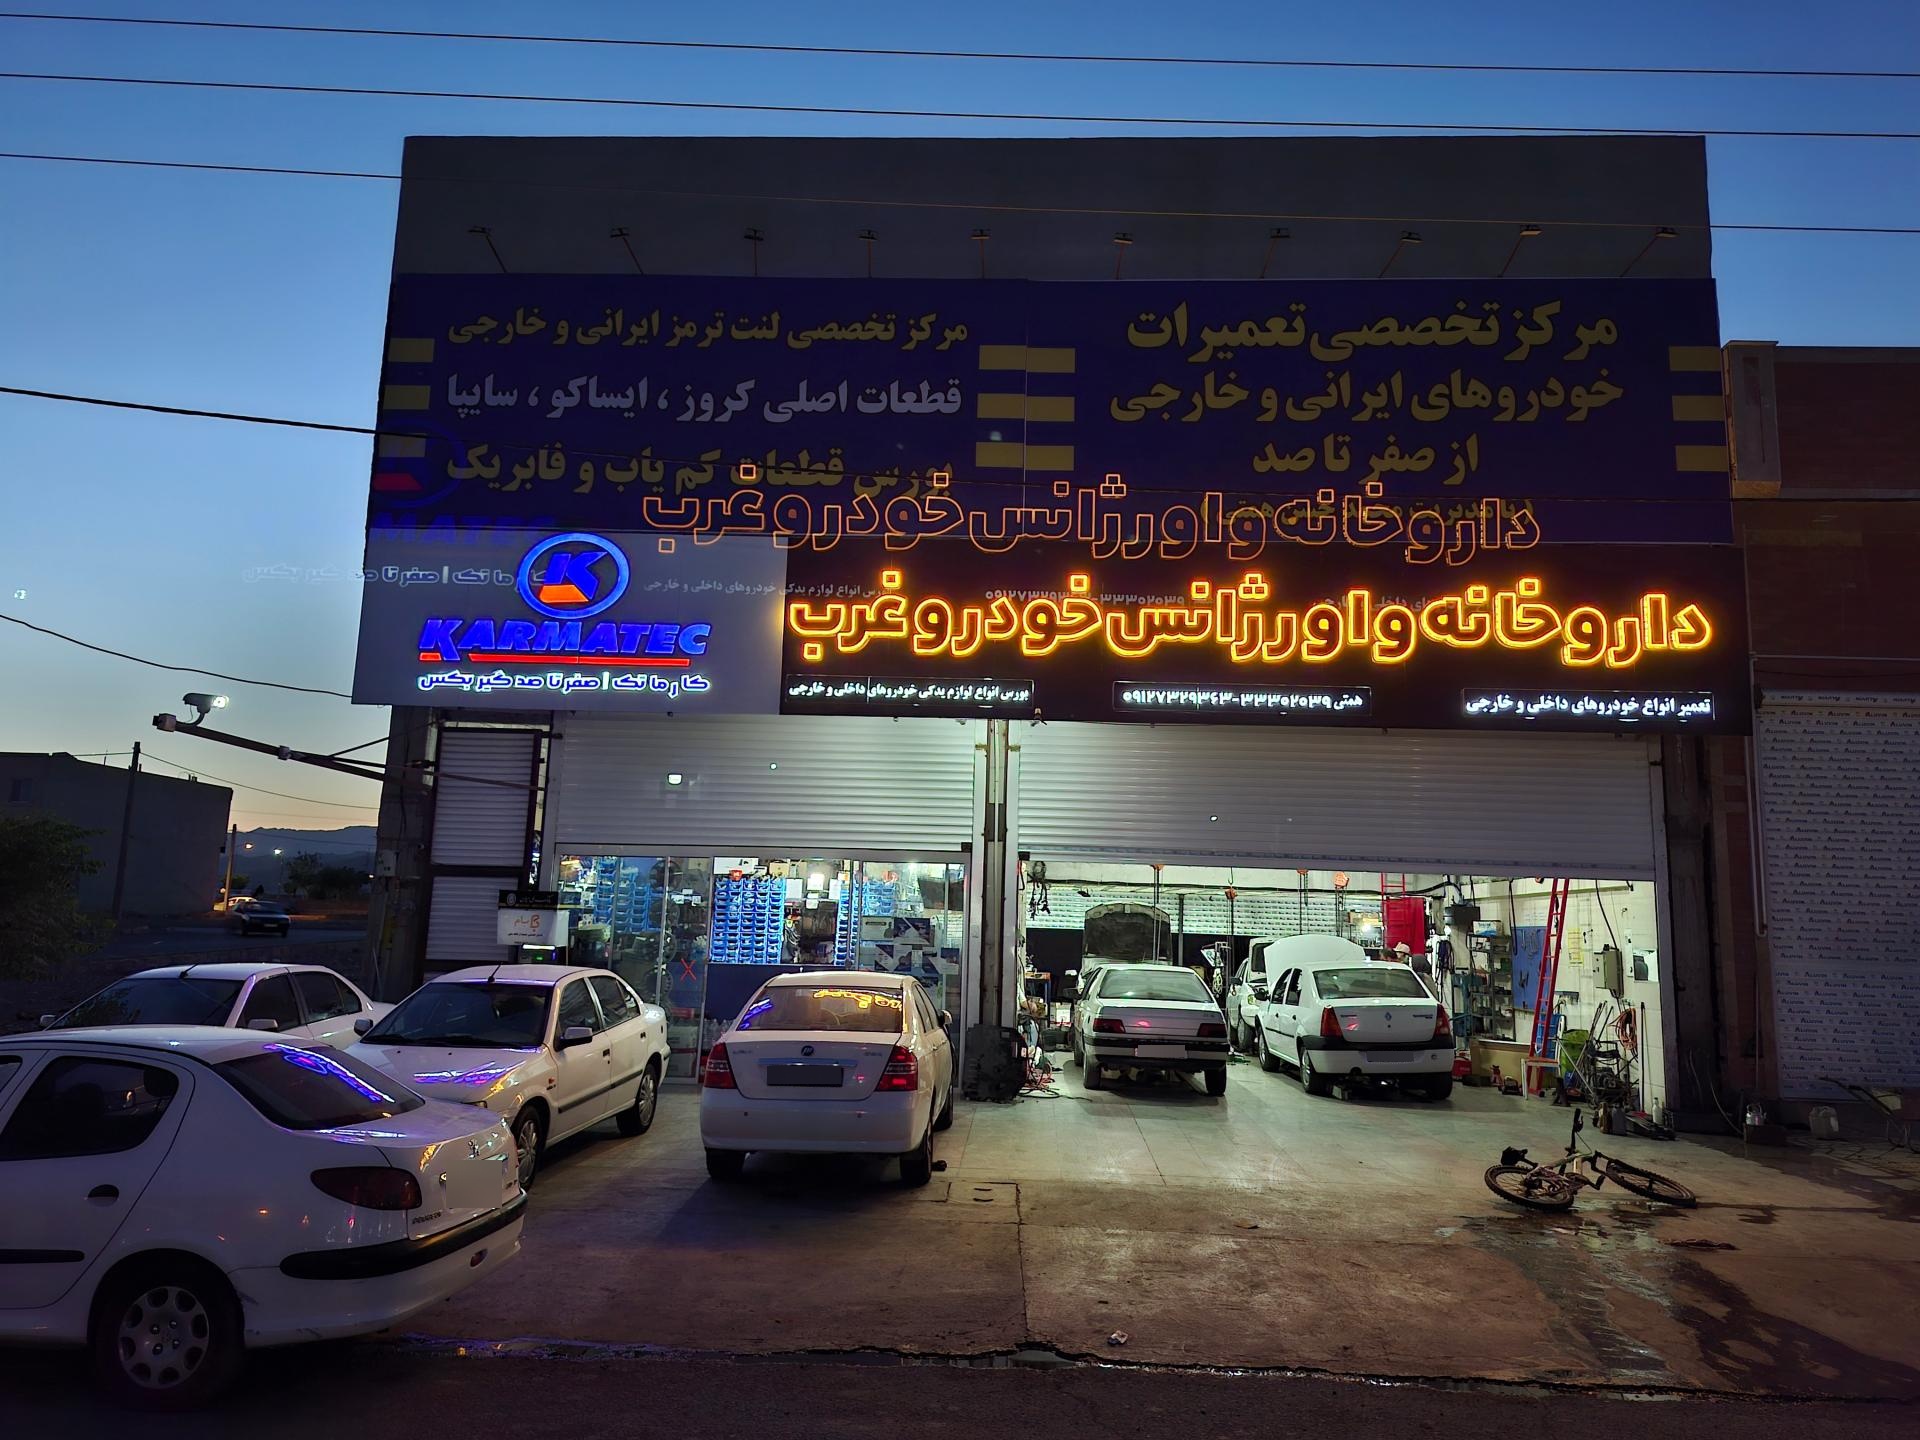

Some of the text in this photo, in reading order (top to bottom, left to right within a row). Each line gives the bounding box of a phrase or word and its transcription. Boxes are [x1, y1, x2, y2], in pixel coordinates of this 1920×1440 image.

[448, 305, 967, 350] مرکز تخصصی لنت ترمز ایرانی و خارجی
[1127, 299, 1618, 363] مرکز تخصصی تعمیرات
[447, 373, 517, 418] سایپا
[545, 375, 647, 420] ایساکو
[675, 379, 756, 422] کروز
[762, 376, 847, 422] اصلی
[856, 377, 963, 415] قطعات
[1109, 367, 1624, 422] خودروهای ایرانی و خارجی
[446, 442, 566, 492] فابریک
[572, 460, 595, 494] و
[730, 447, 845, 487] قطعات
[1252, 432, 1479, 486] از صفر تا صد
[788, 569, 909, 662] غرب
[912, 573, 1104, 657] خودرو
[1106, 572, 1370, 663] اورژانس
[1373, 602, 1418, 664] و
[418, 618, 713, 662] KARMATEC
[514, 672, 545, 690] صد
[562, 671, 602, 695] صفر
[788, 680, 1030, 702] بورس انواع لوازم یدکی خودروهای داخلی و خارجی
[1333, 692, 1364, 711] همتی
[1465, 693, 1712, 716] تعمیر انواع خودروهای داخلی و خارجی
